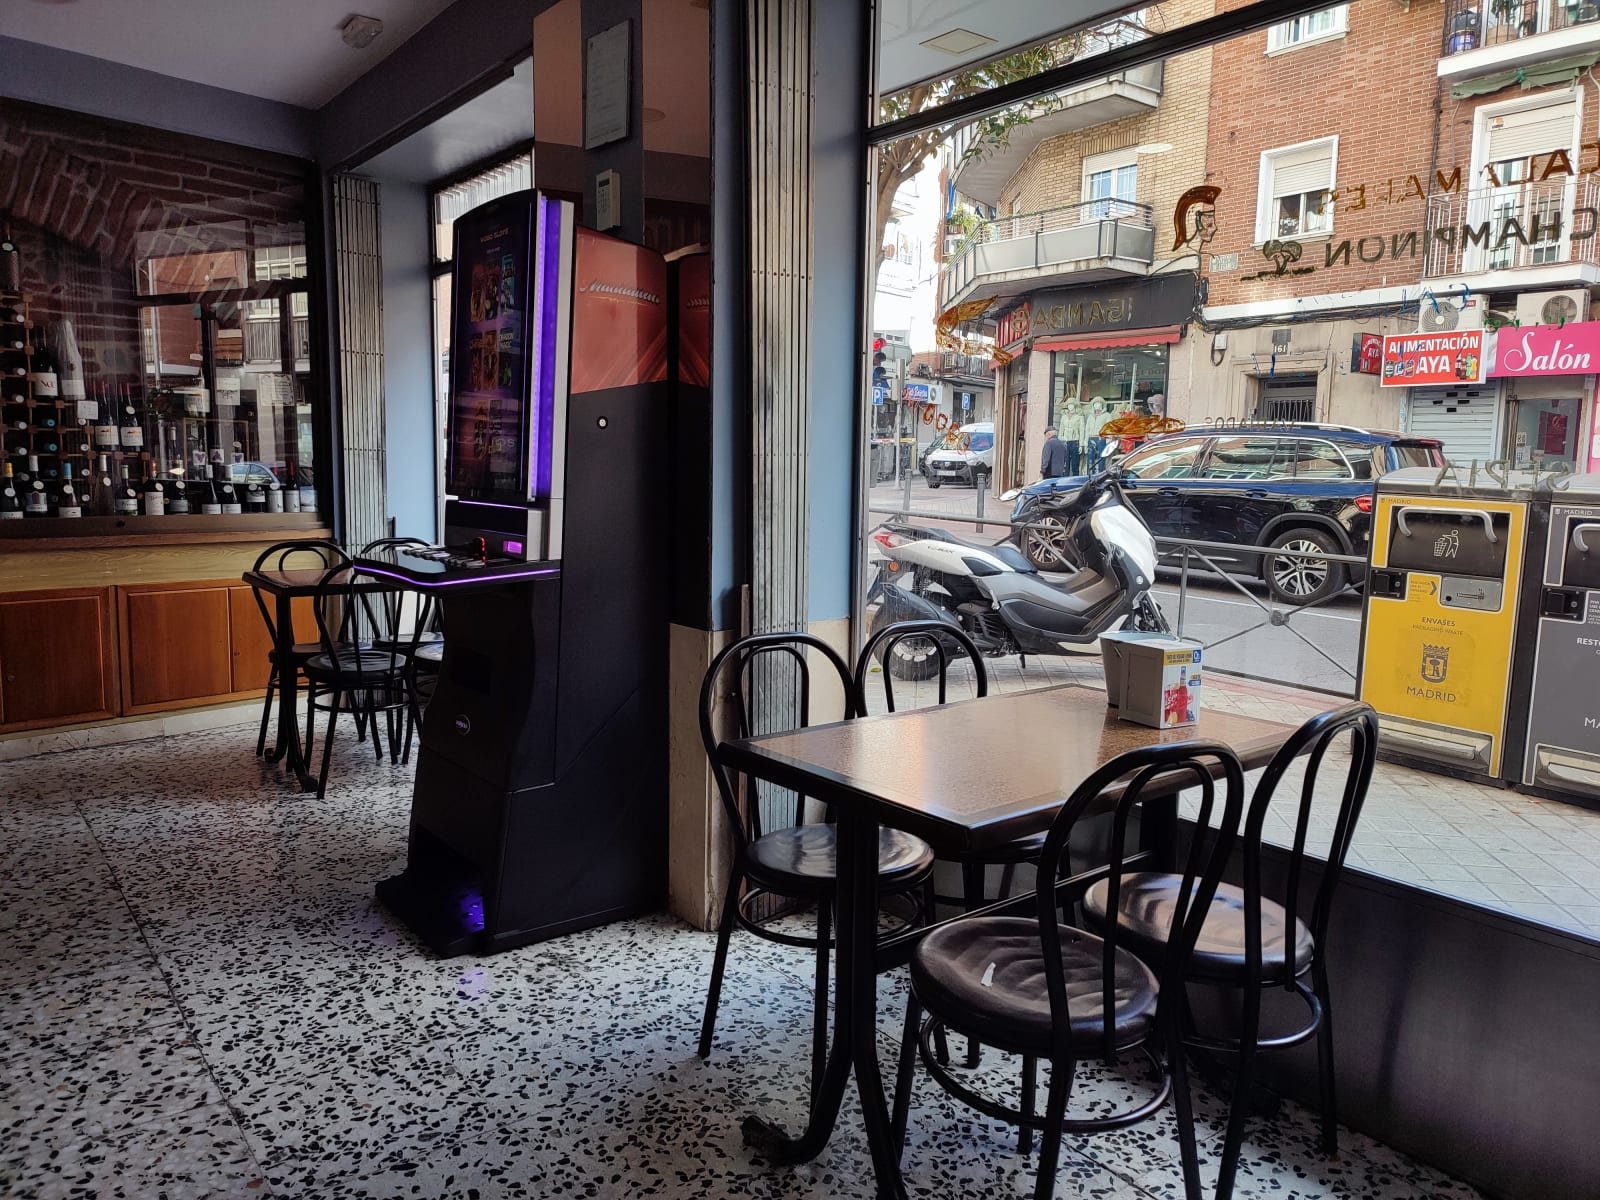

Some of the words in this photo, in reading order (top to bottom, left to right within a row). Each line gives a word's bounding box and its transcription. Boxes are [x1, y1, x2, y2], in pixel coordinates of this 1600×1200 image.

[1274, 344, 1286, 353] 161
[1388, 333, 1478, 354] ALIMENTACIÓN
[1503, 331, 1591, 372] Salón
[1416, 355, 1450, 374] AYA
[1563, 508, 1593, 516] MADRID
[1421, 615, 1456, 627] ENVASES
[1576, 637, 1600, 646] REST
[1406, 685, 1456, 703] MADRID
